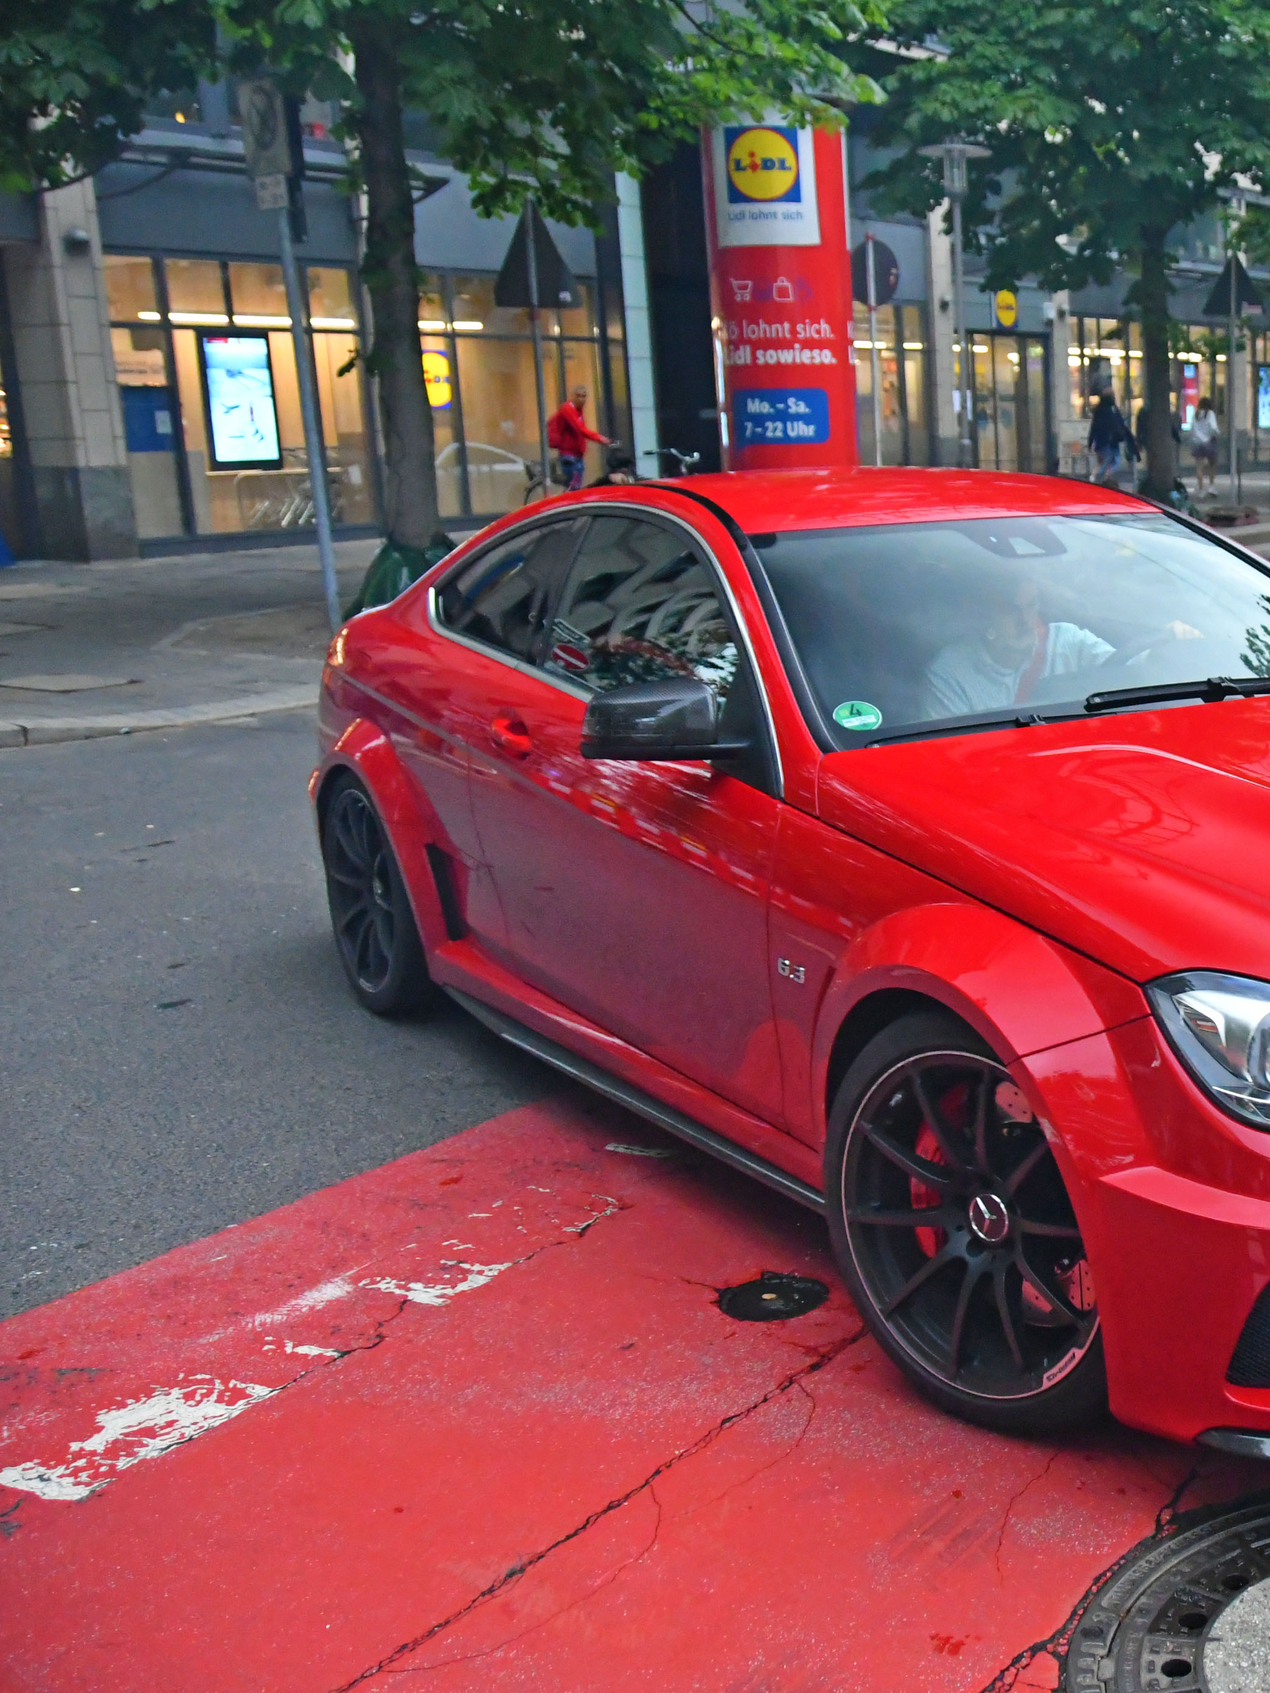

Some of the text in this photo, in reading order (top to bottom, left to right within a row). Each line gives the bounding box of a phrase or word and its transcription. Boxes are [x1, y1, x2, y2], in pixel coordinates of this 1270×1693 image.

[743, 319, 791, 338] lohnt
[796, 319, 836, 338] sich.
[756, 343, 837, 364] sowieso.
[747, 398, 775, 414] Mo.
[787, 397, 812, 414] Sa.
[786, 421, 816, 437] Uhr
[850, 703, 862, 717] 4
[777, 957, 806, 984] 6.3
